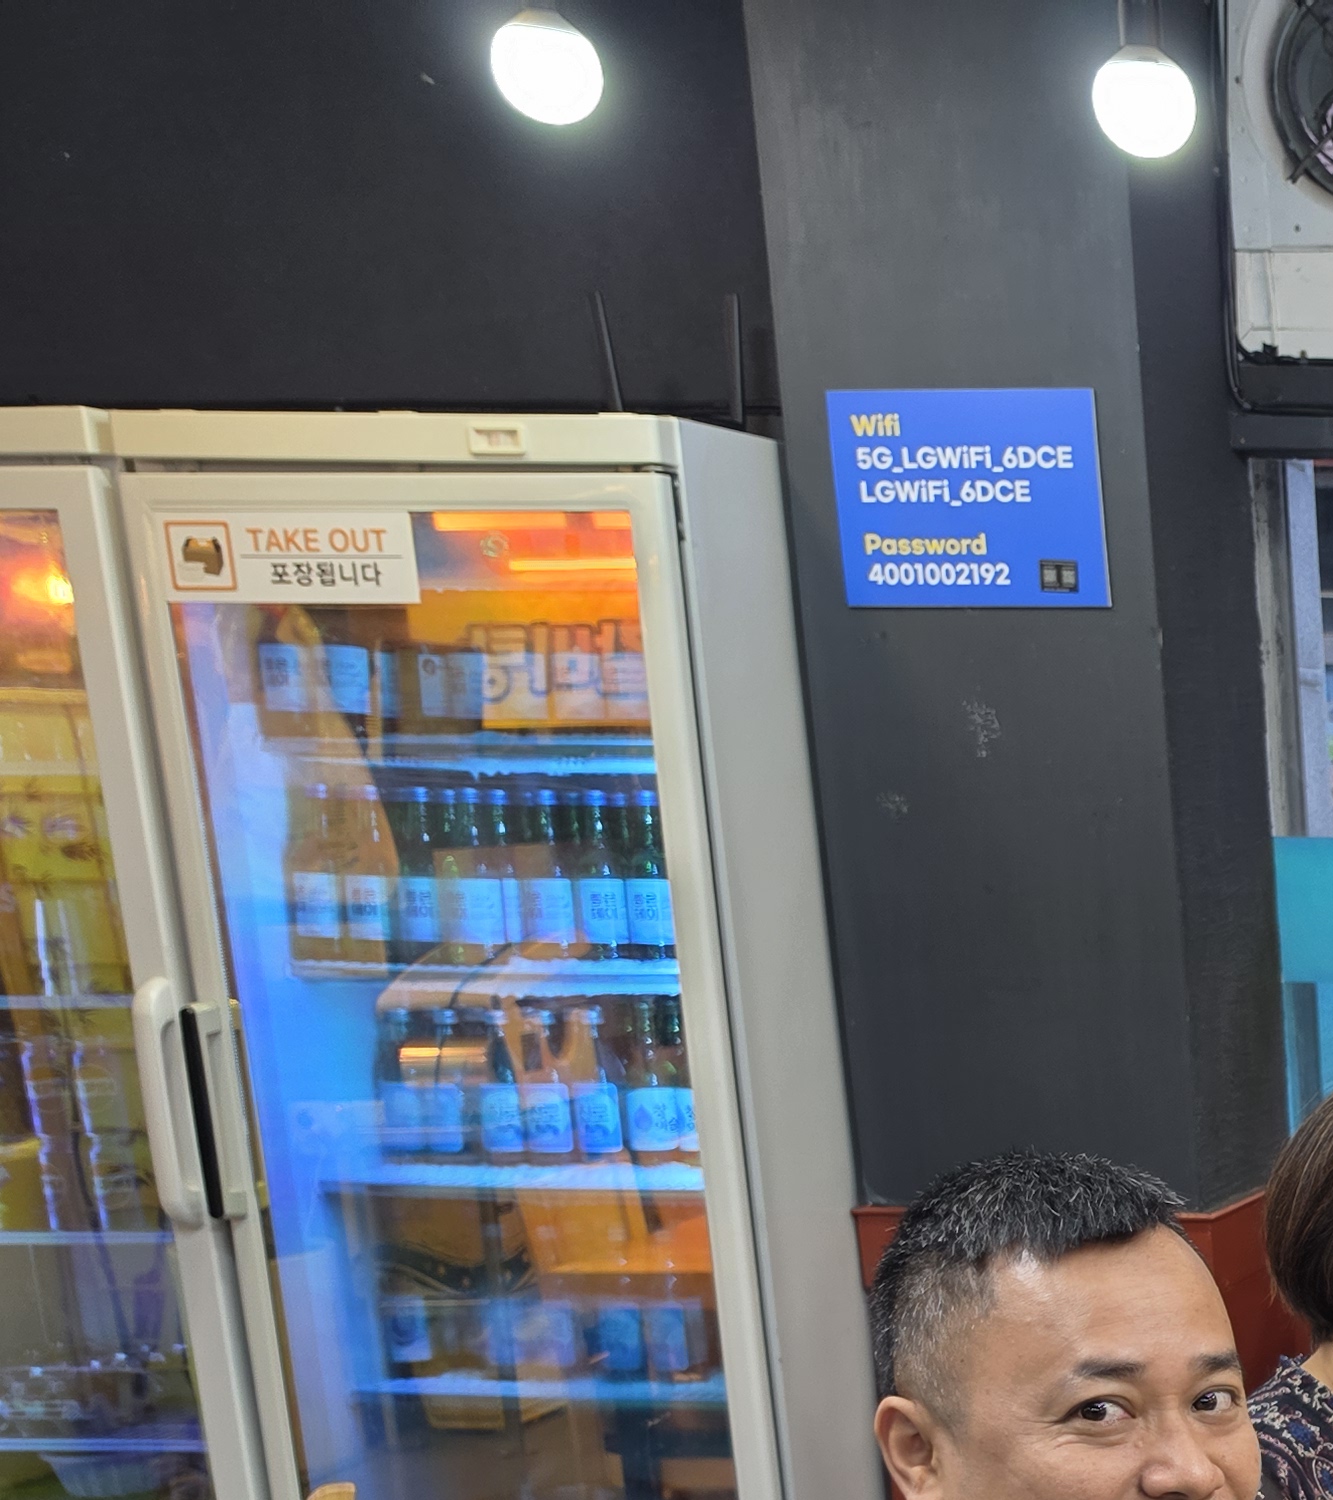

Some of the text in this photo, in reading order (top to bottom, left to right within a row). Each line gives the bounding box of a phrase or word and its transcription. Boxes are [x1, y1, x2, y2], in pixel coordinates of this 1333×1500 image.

[850, 413, 901, 437] Wifi
[855, 445, 1075, 473] 5G_LGWiFi_6DCE
[859, 479, 1032, 507] LGWiFi_6DCE
[245, 527, 388, 553] TAKE OUT
[863, 532, 988, 556] Password
[270, 561, 382, 587] 포장됩니다
[867, 562, 1012, 586] 4001002192
